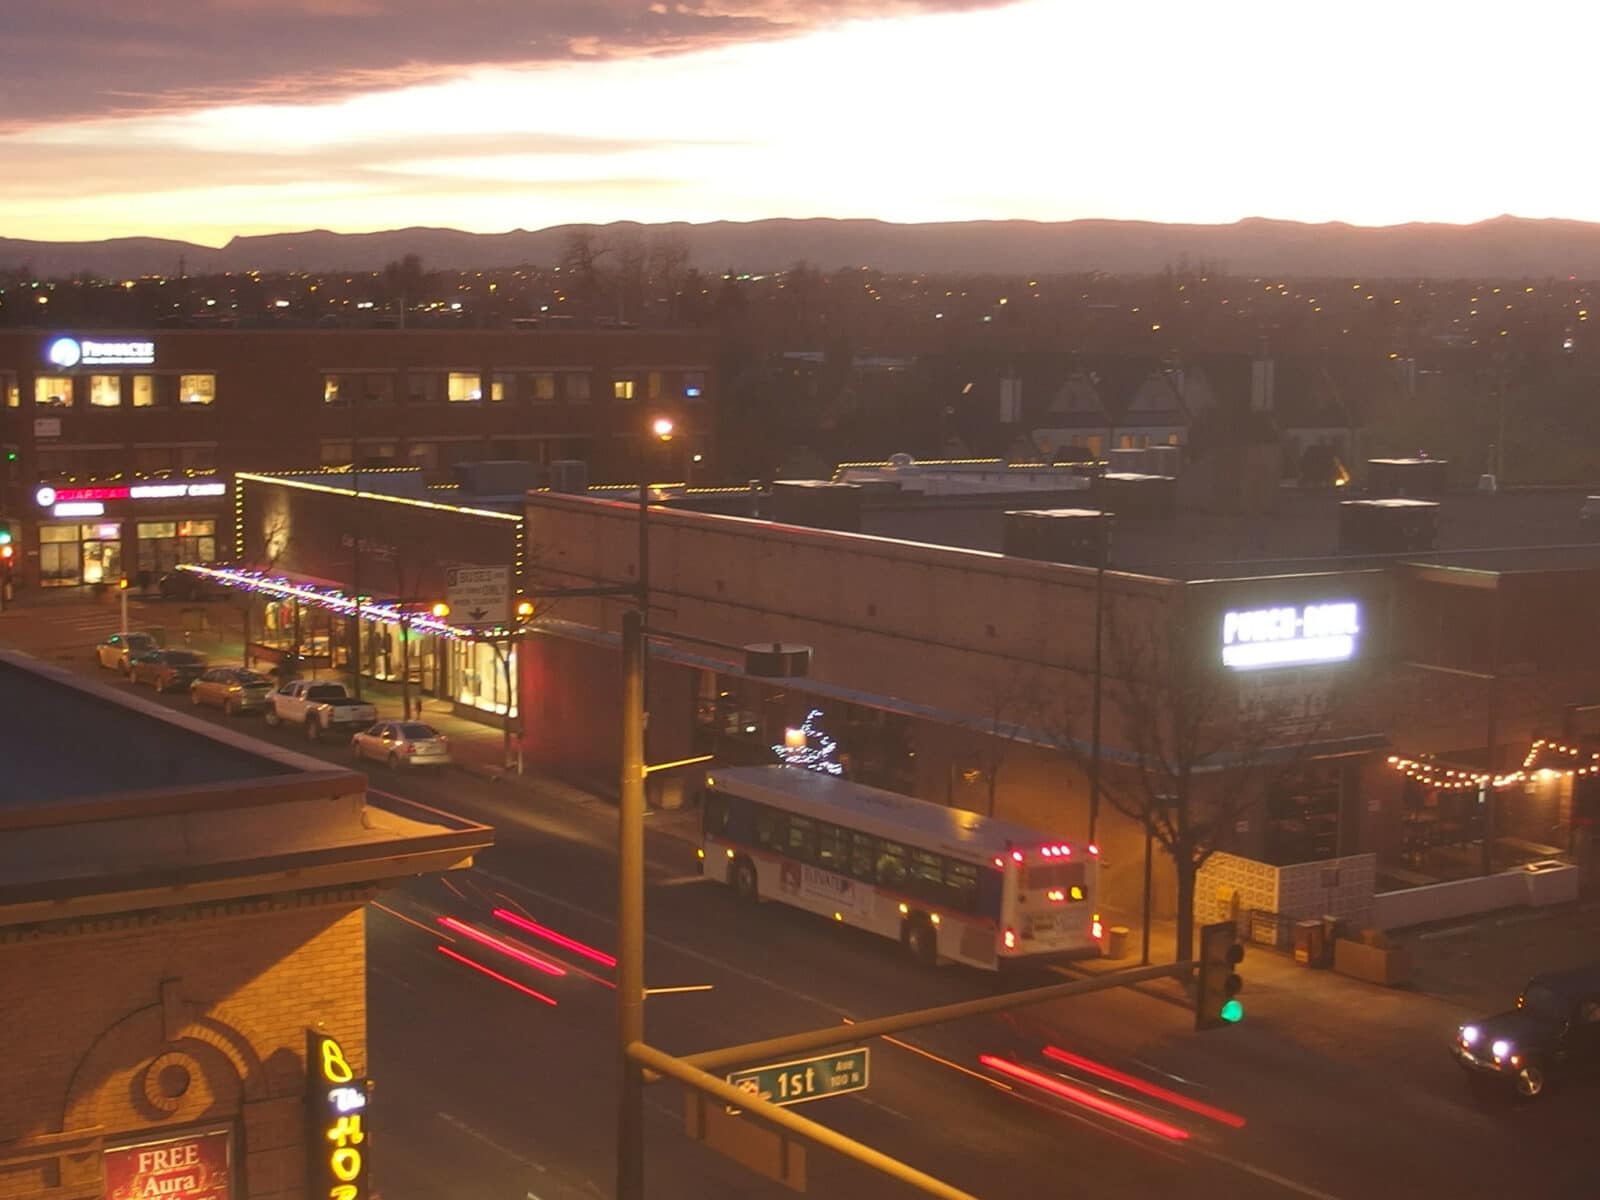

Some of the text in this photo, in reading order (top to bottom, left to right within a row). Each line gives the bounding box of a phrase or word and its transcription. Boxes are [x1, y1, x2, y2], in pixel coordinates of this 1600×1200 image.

[778, 1067, 815, 1097] 1st
[138, 1144, 201, 1173] FREE
[143, 1174, 196, 1197] Aura
